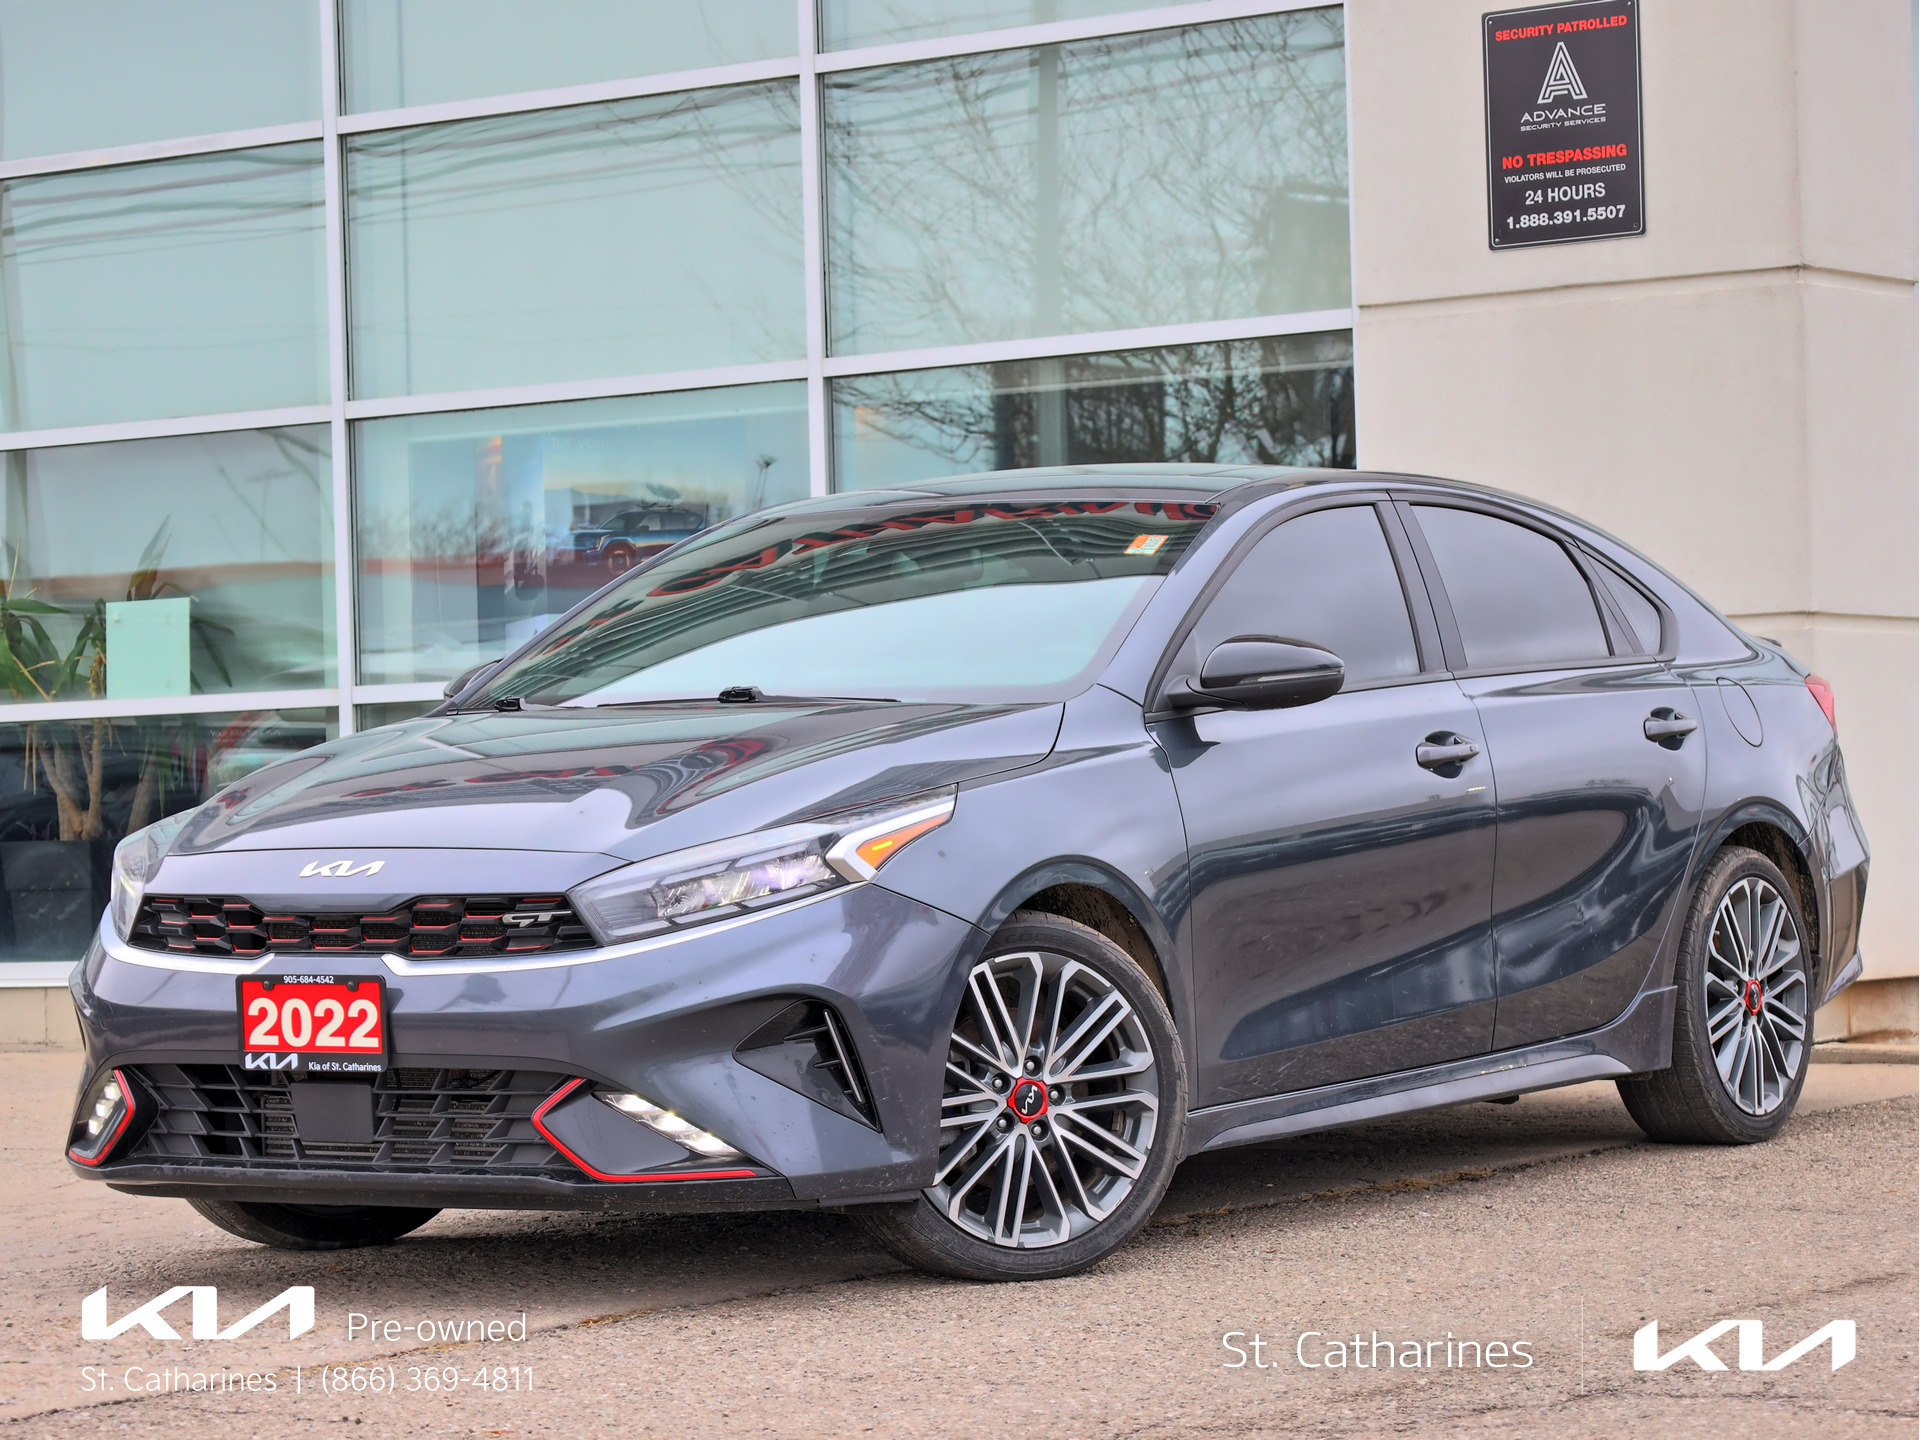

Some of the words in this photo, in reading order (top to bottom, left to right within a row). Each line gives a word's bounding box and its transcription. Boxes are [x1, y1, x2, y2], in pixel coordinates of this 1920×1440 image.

[1495, 24, 1554, 41] SECURITY
[1557, 15, 1628, 34] PATROLLED
[1520, 103, 1606, 124] ADVANCE
[1520, 121, 1562, 132] SECURITY
[1564, 116, 1606, 127] SERVICES
[1502, 155, 1524, 170] NO
[1527, 143, 1628, 167] TRESPASSING
[1504, 172, 1545, 184] VIOLATORS
[1545, 170, 1564, 179] WILL
[1565, 168, 1575, 177] BE
[1576, 163, 1627, 176] PROSECUTED
[1525, 190, 1543, 205] 24
[1547, 182, 1606, 203] HOURS
[1506, 204, 1626, 230] 1.888.391.5507
[299, 860, 386, 878] KIA
[501, 910, 573, 928] GT
[283, 975, 335, 985] 905-684-4542
[247, 997, 380, 1048] 2022
[244, 1052, 299, 1070] KIA
[308, 1061, 321, 1071] Kia
[322, 1061, 330, 1071] of
[331, 1061, 342, 1071] St.
[343, 1061, 382, 1072] Catharines
